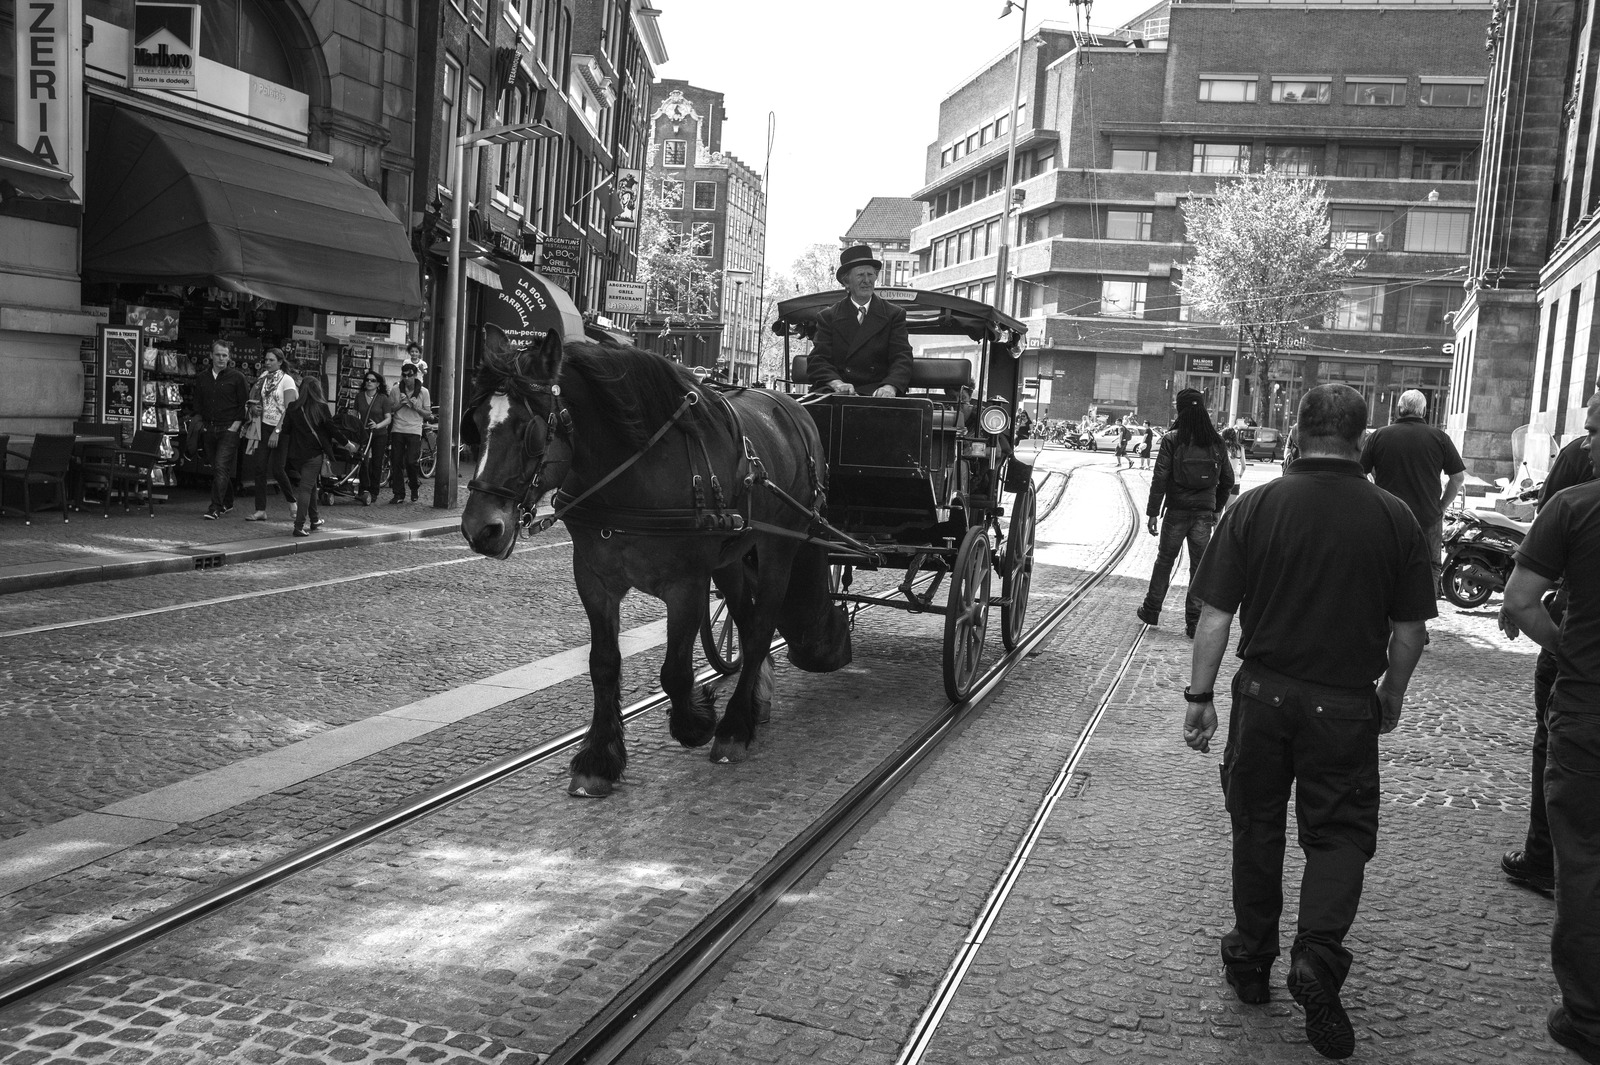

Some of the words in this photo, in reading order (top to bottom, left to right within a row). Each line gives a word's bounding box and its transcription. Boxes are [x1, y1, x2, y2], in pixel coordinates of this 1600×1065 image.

[134, 43, 192, 69] Marlboro
[29, 3, 59, 165] ZERIA
[545, 237, 580, 246] ARGENTIJNS
[543, 250, 555, 260] LA
[555, 249, 579, 264] BOCA
[549, 258, 571, 268] GRILL
[541, 265, 577, 275] PARRILLA
[515, 289, 536, 312] GRILL
[518, 278, 530, 290] LA
[528, 286, 547, 310] BOCA
[498, 292, 530, 328] PARRILLA
